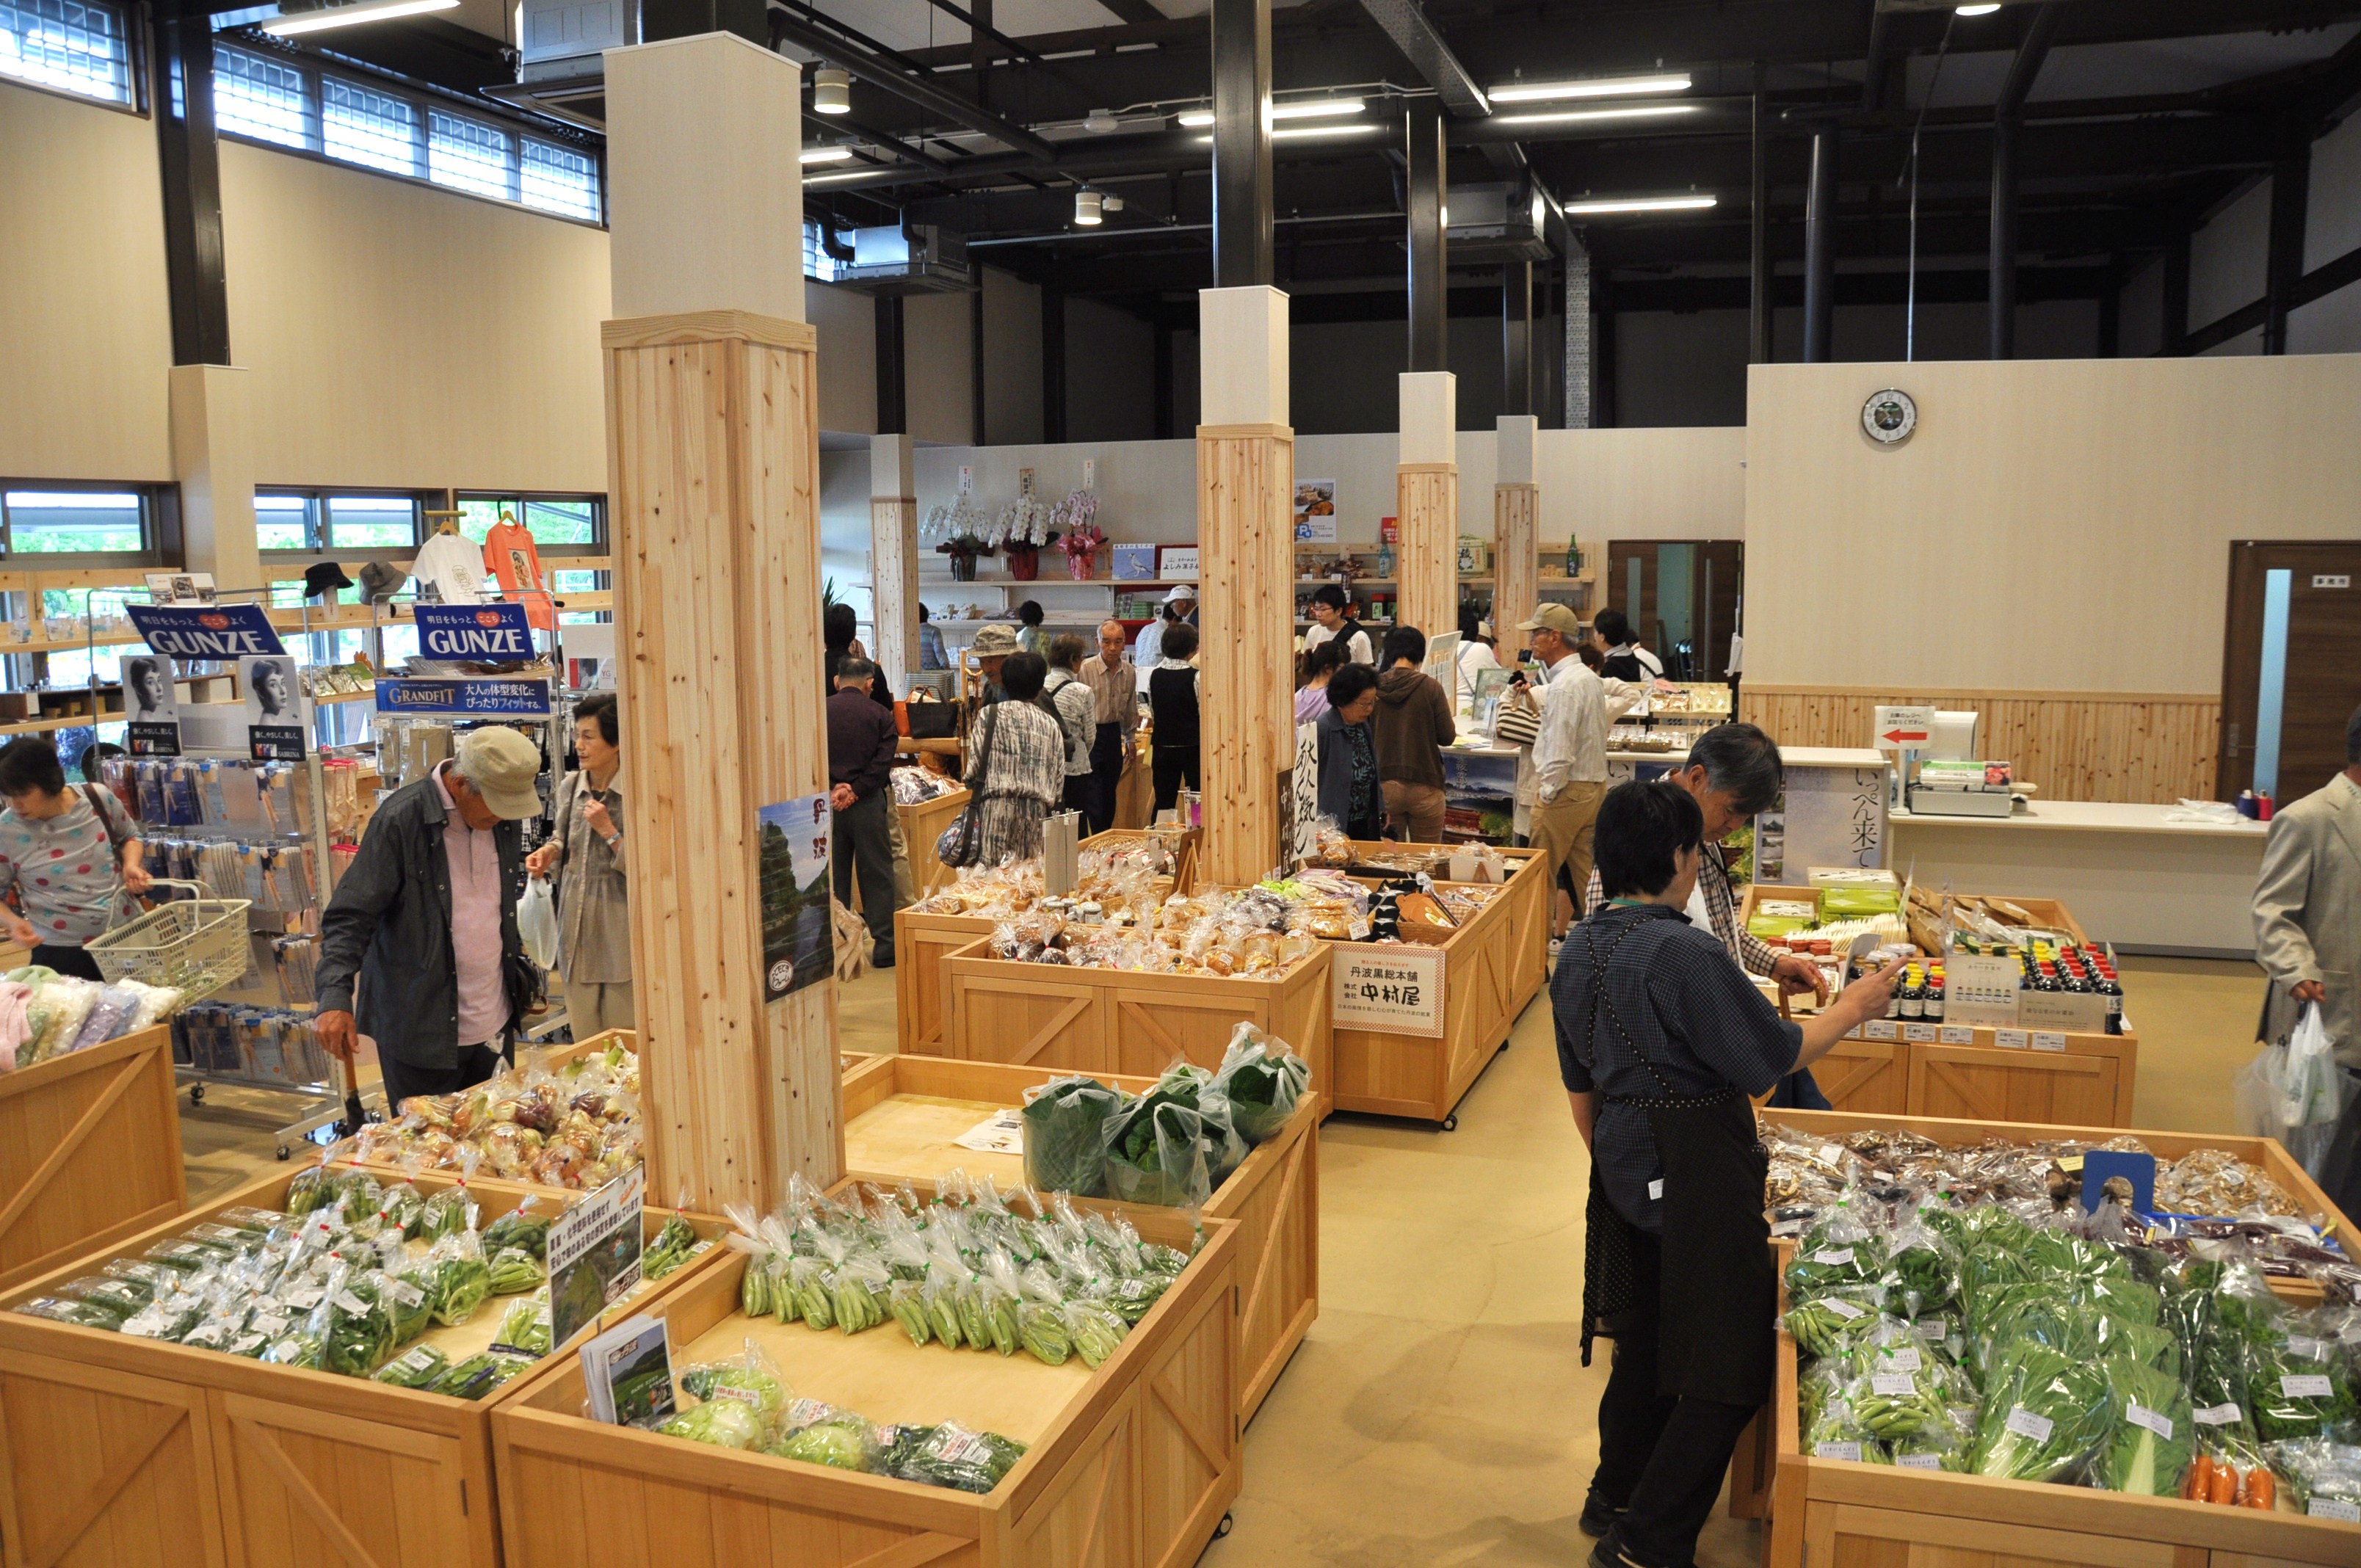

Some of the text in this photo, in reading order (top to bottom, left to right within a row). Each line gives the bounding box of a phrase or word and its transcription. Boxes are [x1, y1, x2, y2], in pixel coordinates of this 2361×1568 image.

[427, 614, 514, 625] 明日をもっと、ここちよく
[148, 630, 269, 655] GUNZE
[427, 628, 526, 654] GUNZE
[465, 683, 535, 697] 大人の体型変化に
[466, 697, 542, 709] ぴったりフィットする。
[278, 750, 300, 758] SABRINA
[1851, 768, 1879, 868] いっぺん来て
[812, 797, 828, 860] 丹波
[1350, 966, 1418, 983] 丹波黒総本舗
[1360, 982, 1421, 1006] 中村屋
